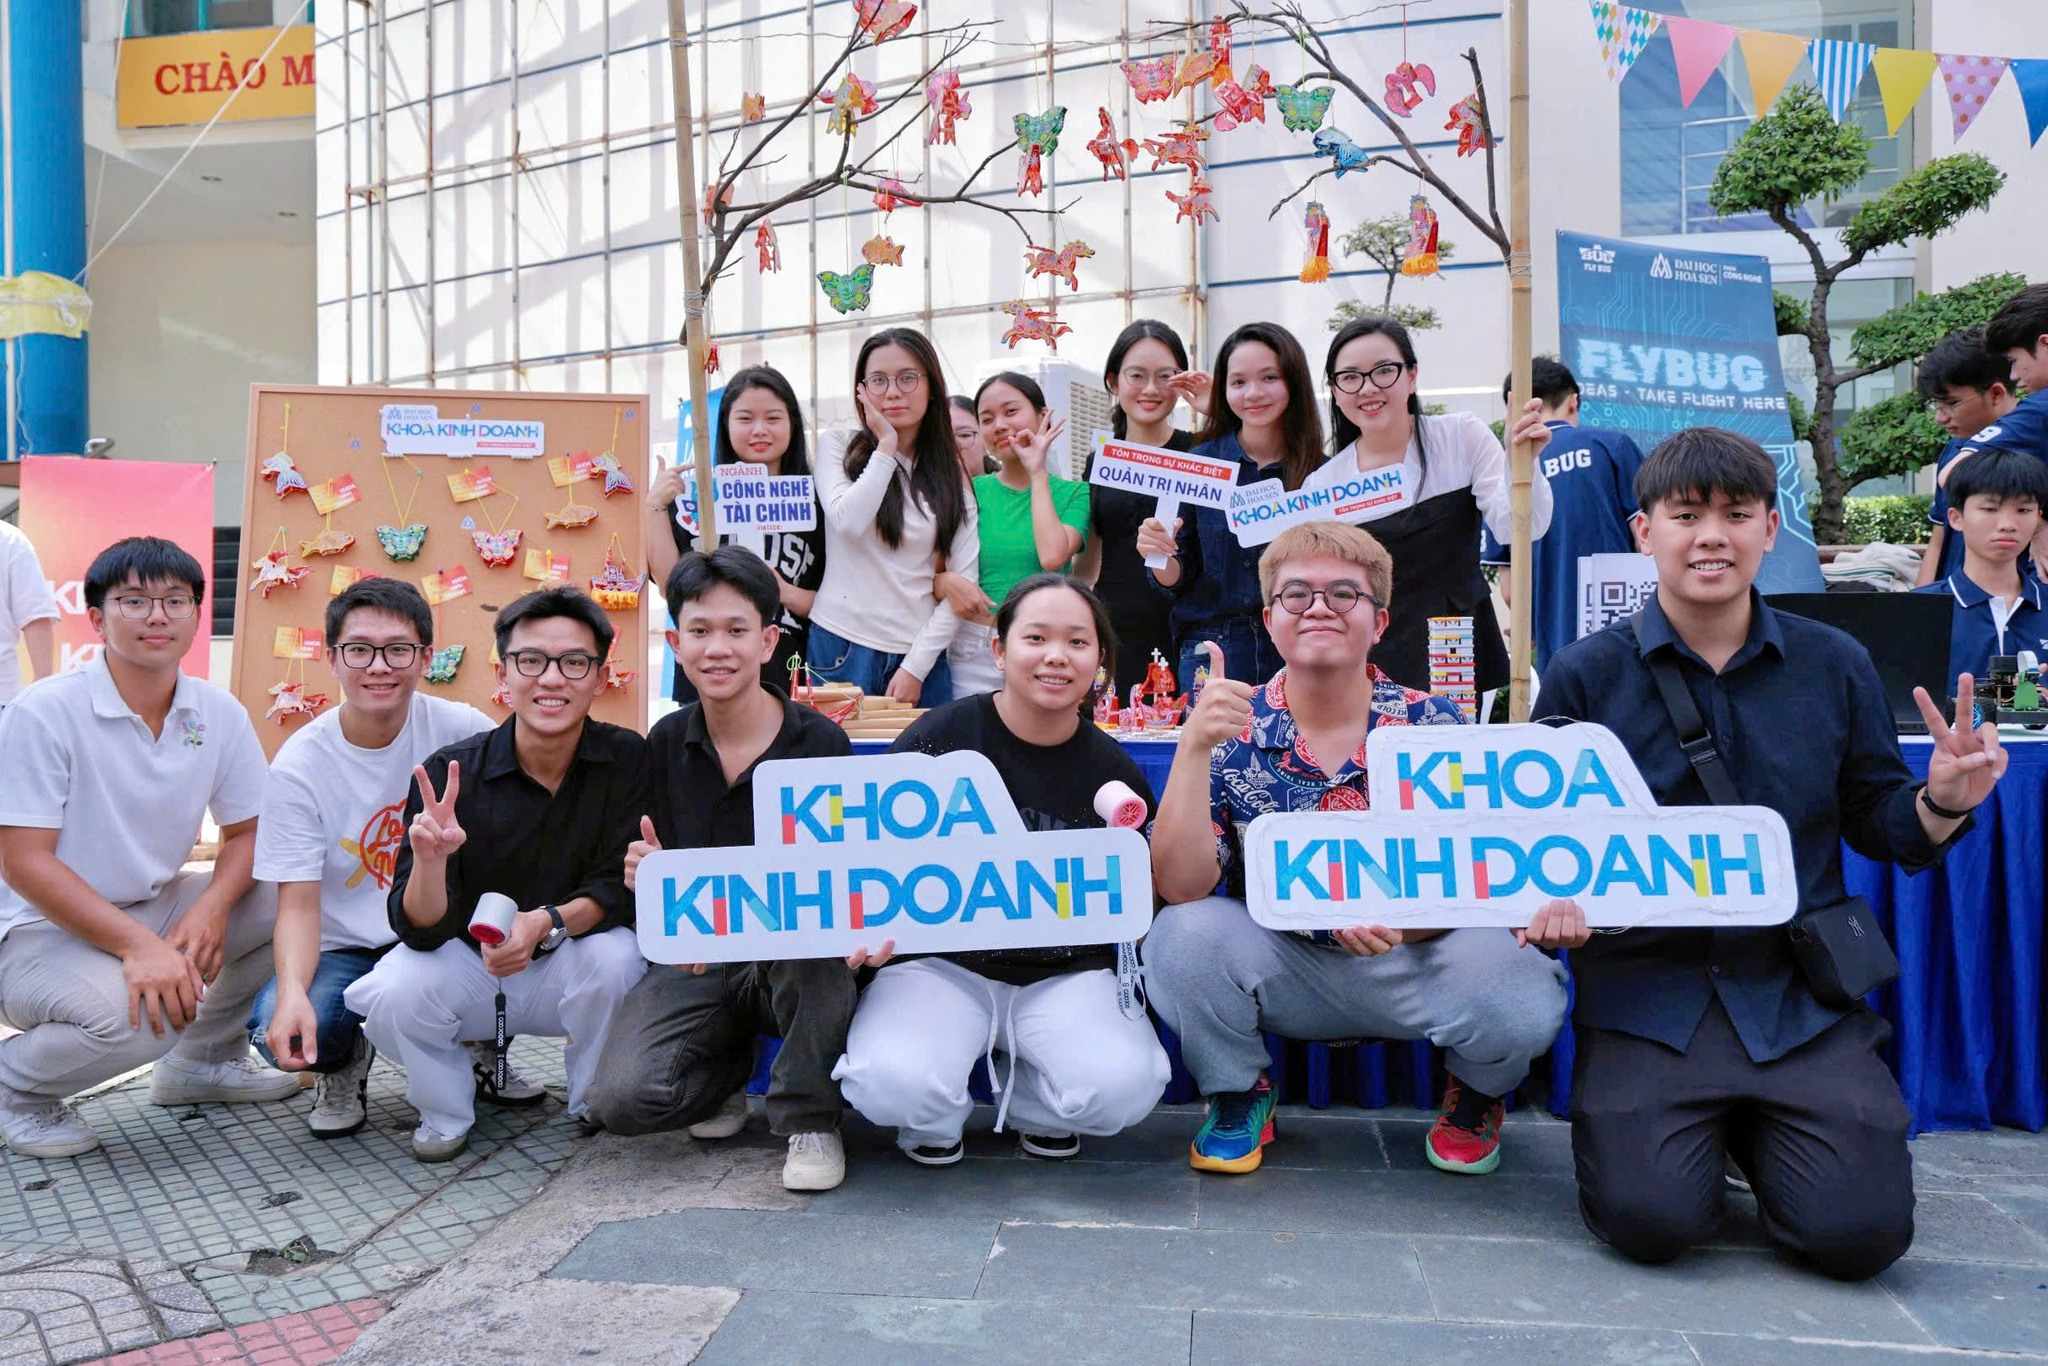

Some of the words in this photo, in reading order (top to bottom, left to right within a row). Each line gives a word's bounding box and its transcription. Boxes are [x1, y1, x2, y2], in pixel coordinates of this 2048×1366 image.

[154, 51, 266, 95] CHÀO
[1577, 338, 1769, 393] FLYBUG
[1577, 382, 1617, 398] DEAS
[1638, 387, 1677, 404] TAKE
[1682, 391, 1736, 409] FLIGHT
[1743, 396, 1786, 410] HERE
[386, 423, 435, 436] KHOA
[437, 423, 476, 437] KINH
[478, 424, 539, 438] DOANH
[719, 464, 763, 477] NGÀNH
[1111, 447, 1131, 458] TÔN
[1131, 452, 1162, 465] TRỌNG
[1177, 460, 1202, 472] KHÁC
[1543, 448, 1592, 478] BUG
[722, 479, 766, 500] CÔNG
[769, 477, 810, 501] NGHỆ
[1099, 465, 1145, 487] QUẢN
[1148, 475, 1173, 496] TRỊ
[1174, 480, 1223, 502] NHÂN
[1232, 502, 1286, 527] KHOA
[1287, 488, 1330, 513] KINH
[1332, 470, 1402, 502] DOANH
[723, 502, 752, 523] TÀI
[756, 502, 811, 522] CHÍNH
[1396, 748, 1626, 811] KHOA
[780, 776, 997, 844] KHOA
[1273, 836, 1458, 902] KINH
[1470, 832, 1767, 901] DOANH
[662, 869, 834, 937] KINH
[847, 854, 1123, 931] DOANH
